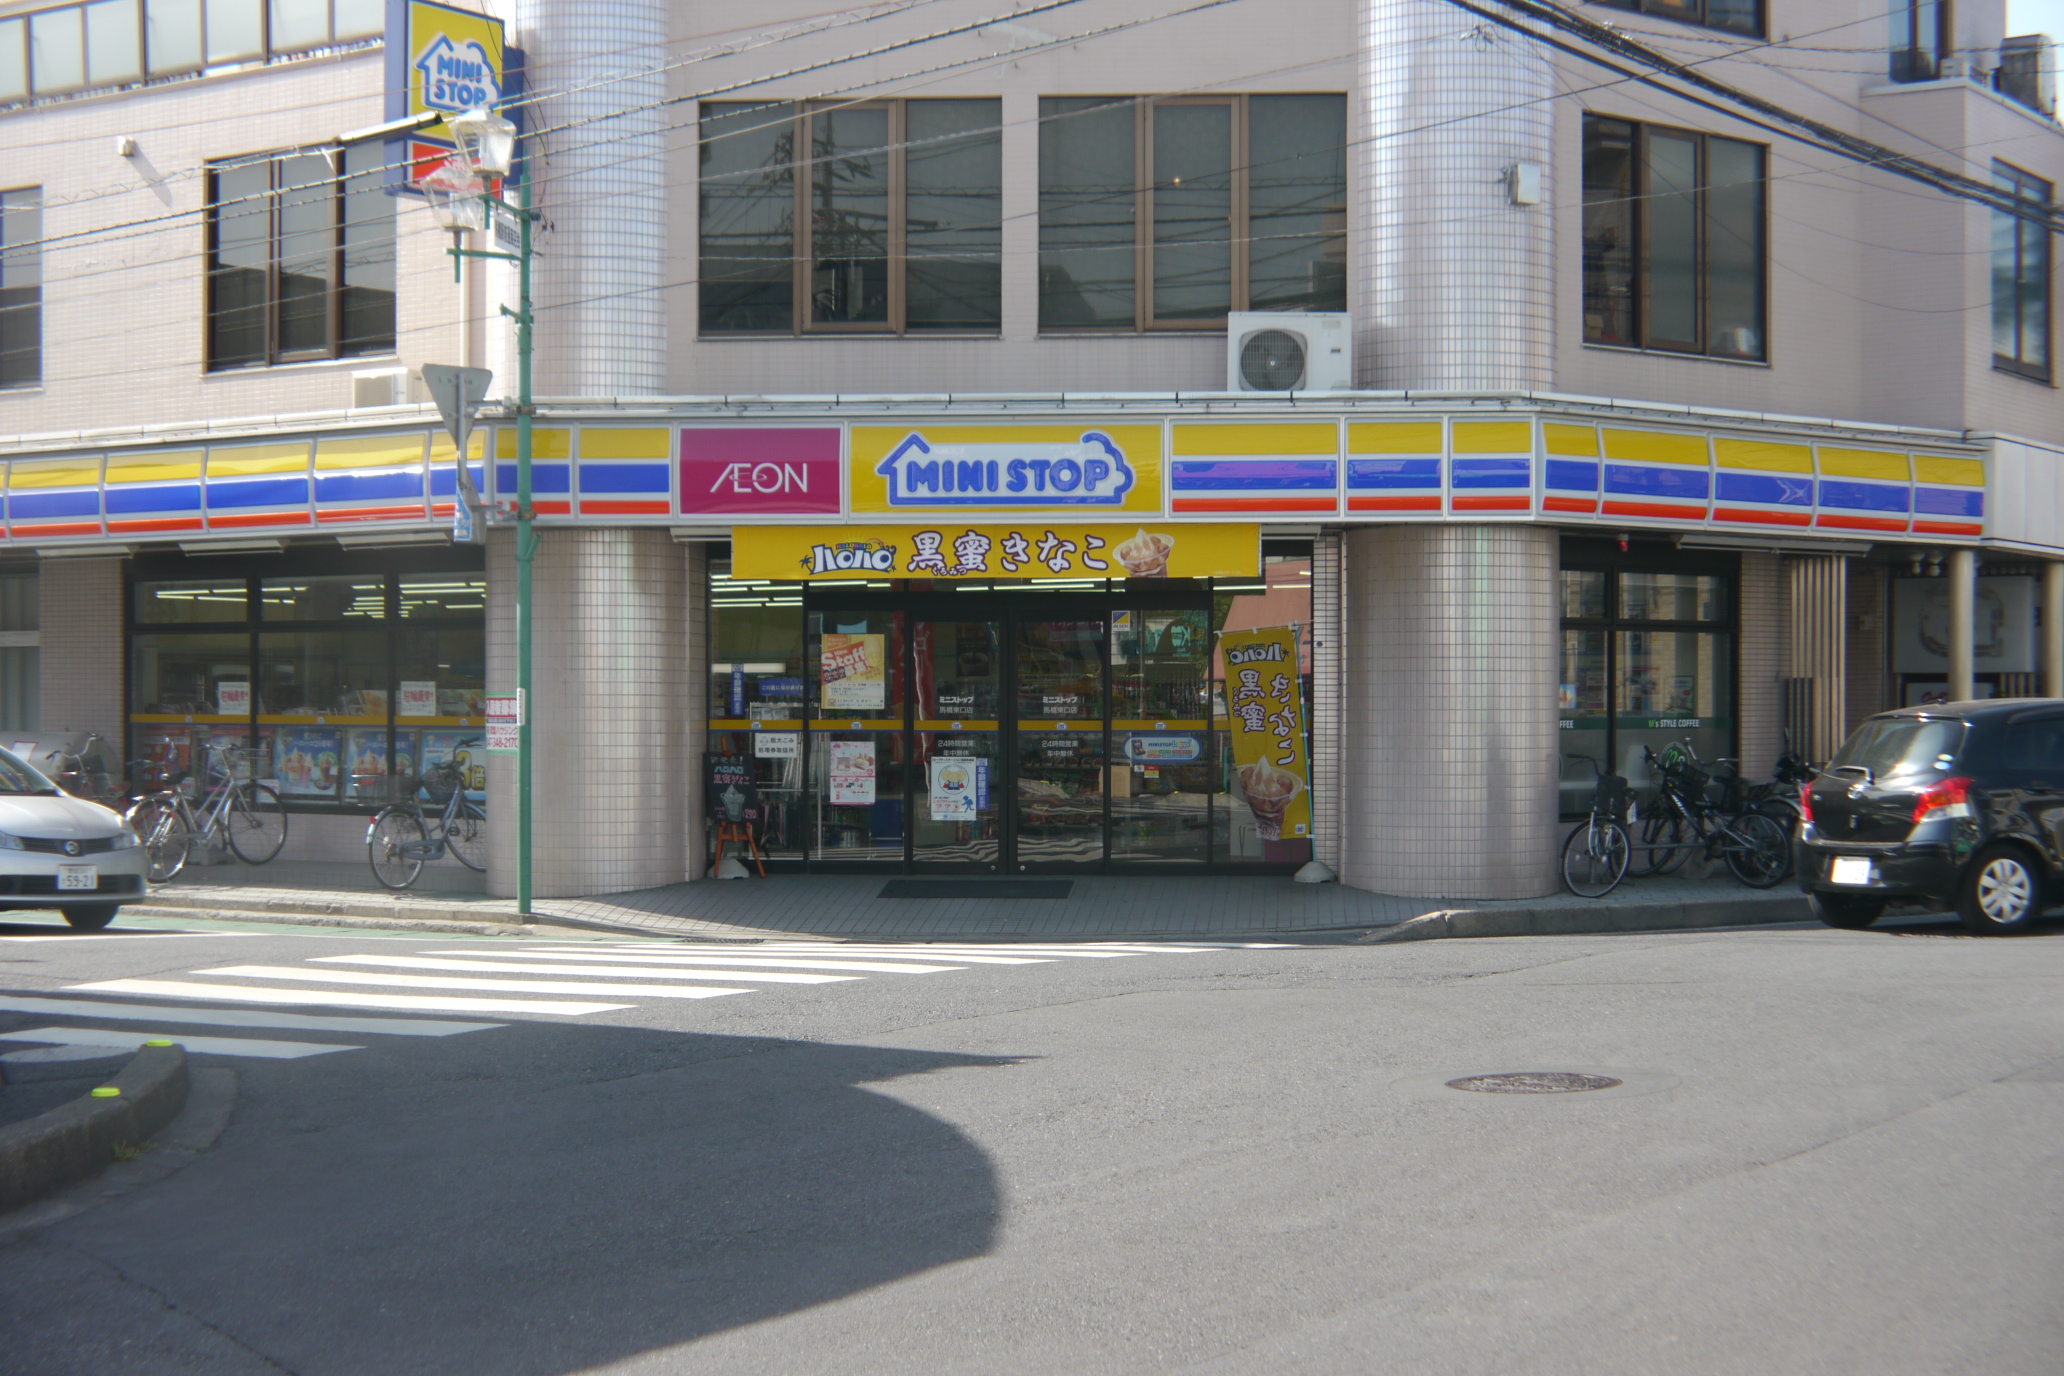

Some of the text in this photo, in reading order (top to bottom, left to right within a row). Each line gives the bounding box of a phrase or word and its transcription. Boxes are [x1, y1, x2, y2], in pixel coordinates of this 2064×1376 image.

[437, 53, 483, 84] MINI
[434, 77, 487, 107] STOP
[905, 458, 1110, 493] MINI STOP
[906, 529, 1110, 573] 黒蜜きなこ
[821, 645, 866, 671] Staff
[938, 696, 974, 704] ミニストップ
[1042, 696, 1078, 704] ミニストップ
[1660, 719, 1677, 728] STYLE
[1678, 719, 1700, 728] COFFEE
[1042, 740, 1078, 748] 24時間営業
[714, 765, 744, 774] ハロハロ
